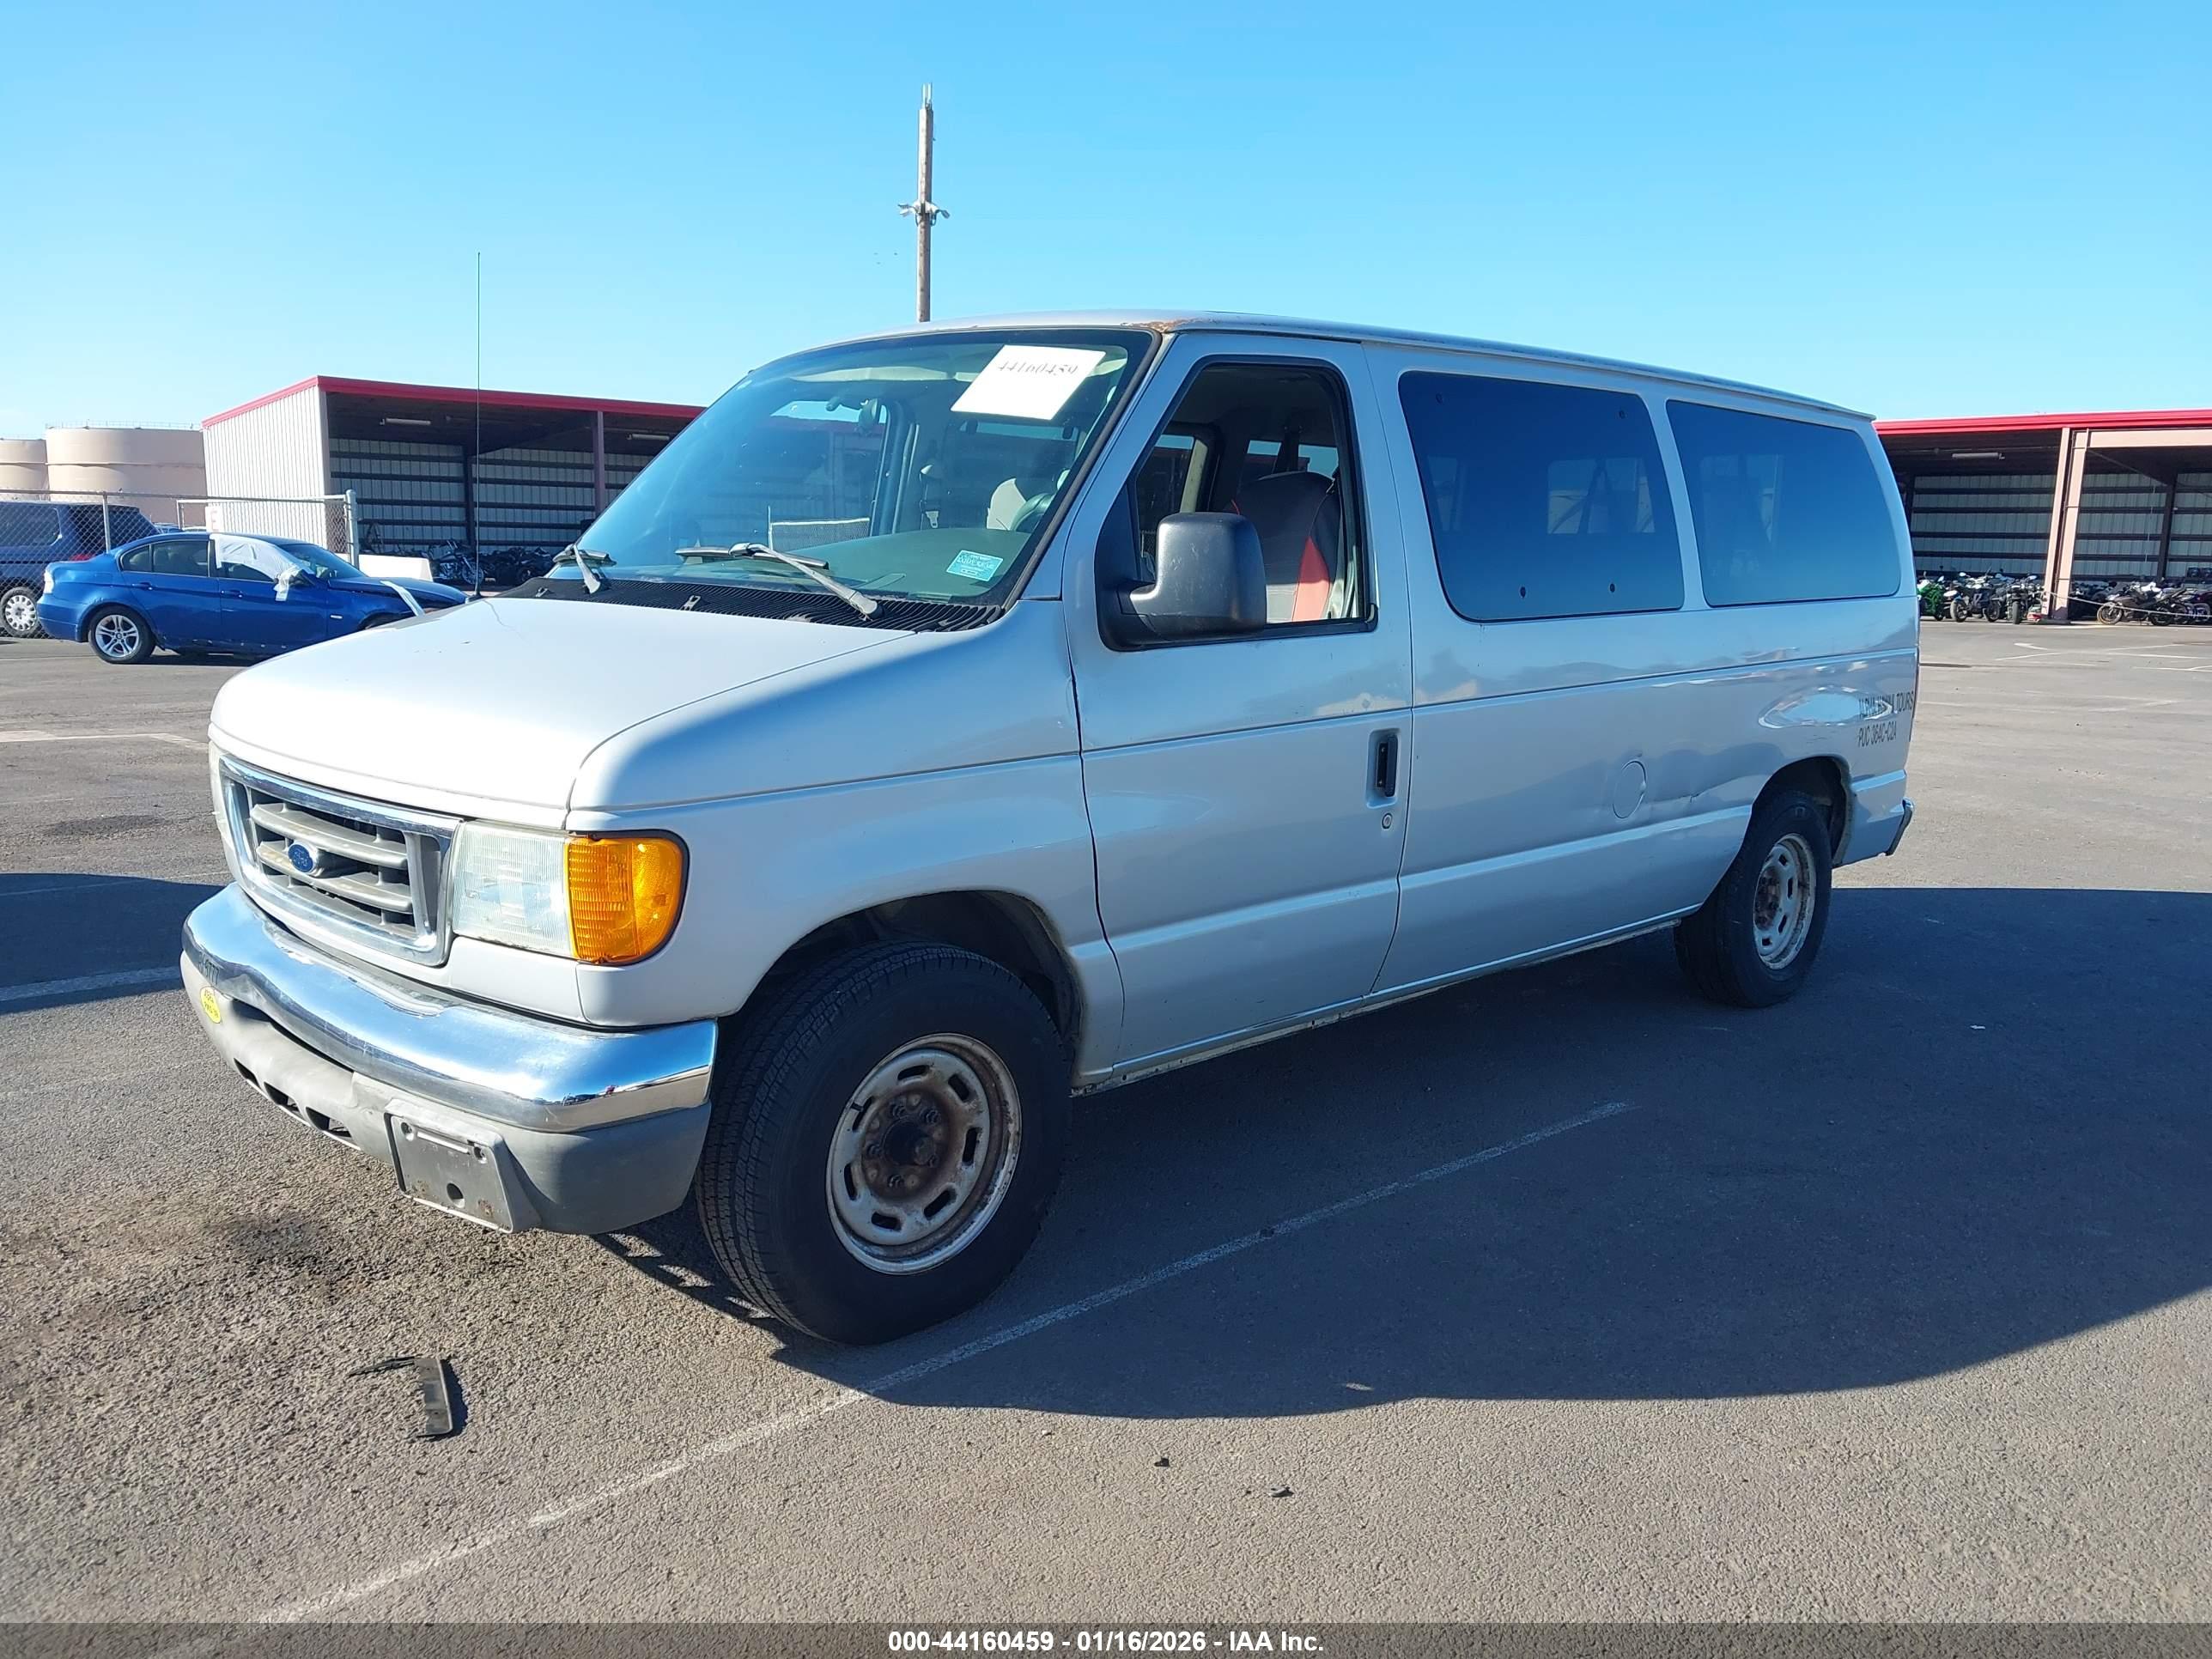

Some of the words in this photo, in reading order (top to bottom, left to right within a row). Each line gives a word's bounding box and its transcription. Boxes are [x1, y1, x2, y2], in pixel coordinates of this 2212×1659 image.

[998, 361, 1079, 374] 44160459
[1896, 690, 1914, 712] TOURS
[1858, 725, 1870, 748] PUC
